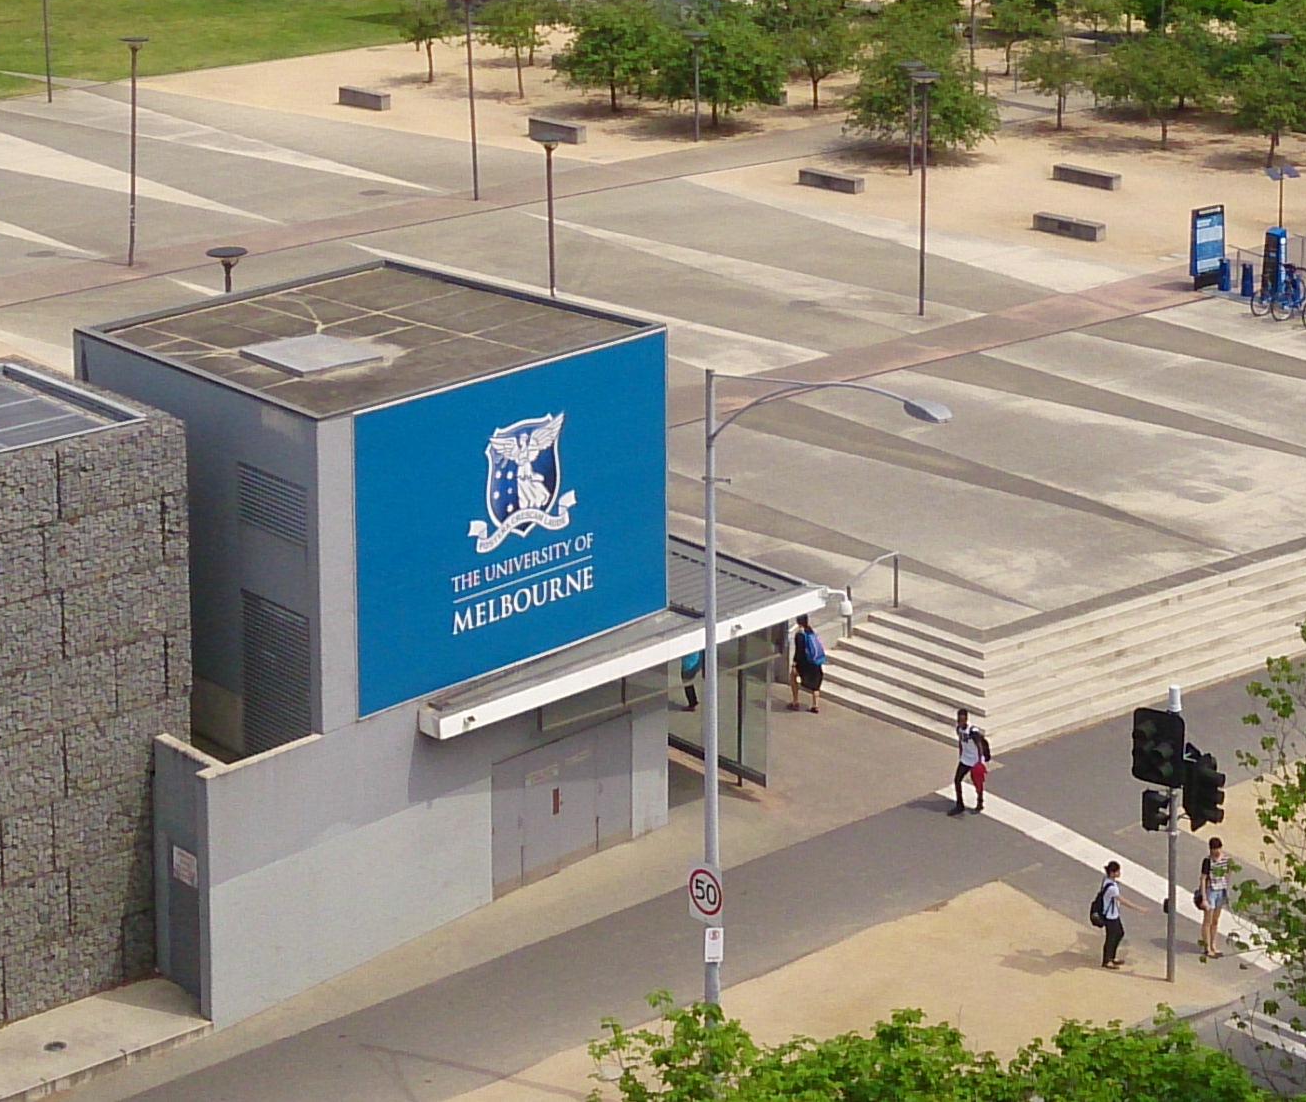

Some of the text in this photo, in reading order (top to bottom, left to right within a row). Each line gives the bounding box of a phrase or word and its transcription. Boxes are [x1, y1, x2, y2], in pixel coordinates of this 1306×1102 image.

[451, 532, 594, 593] THE UNIVERSITY OF
[452, 565, 594, 635] MELBOURNE
[695, 878, 717, 906] 50
